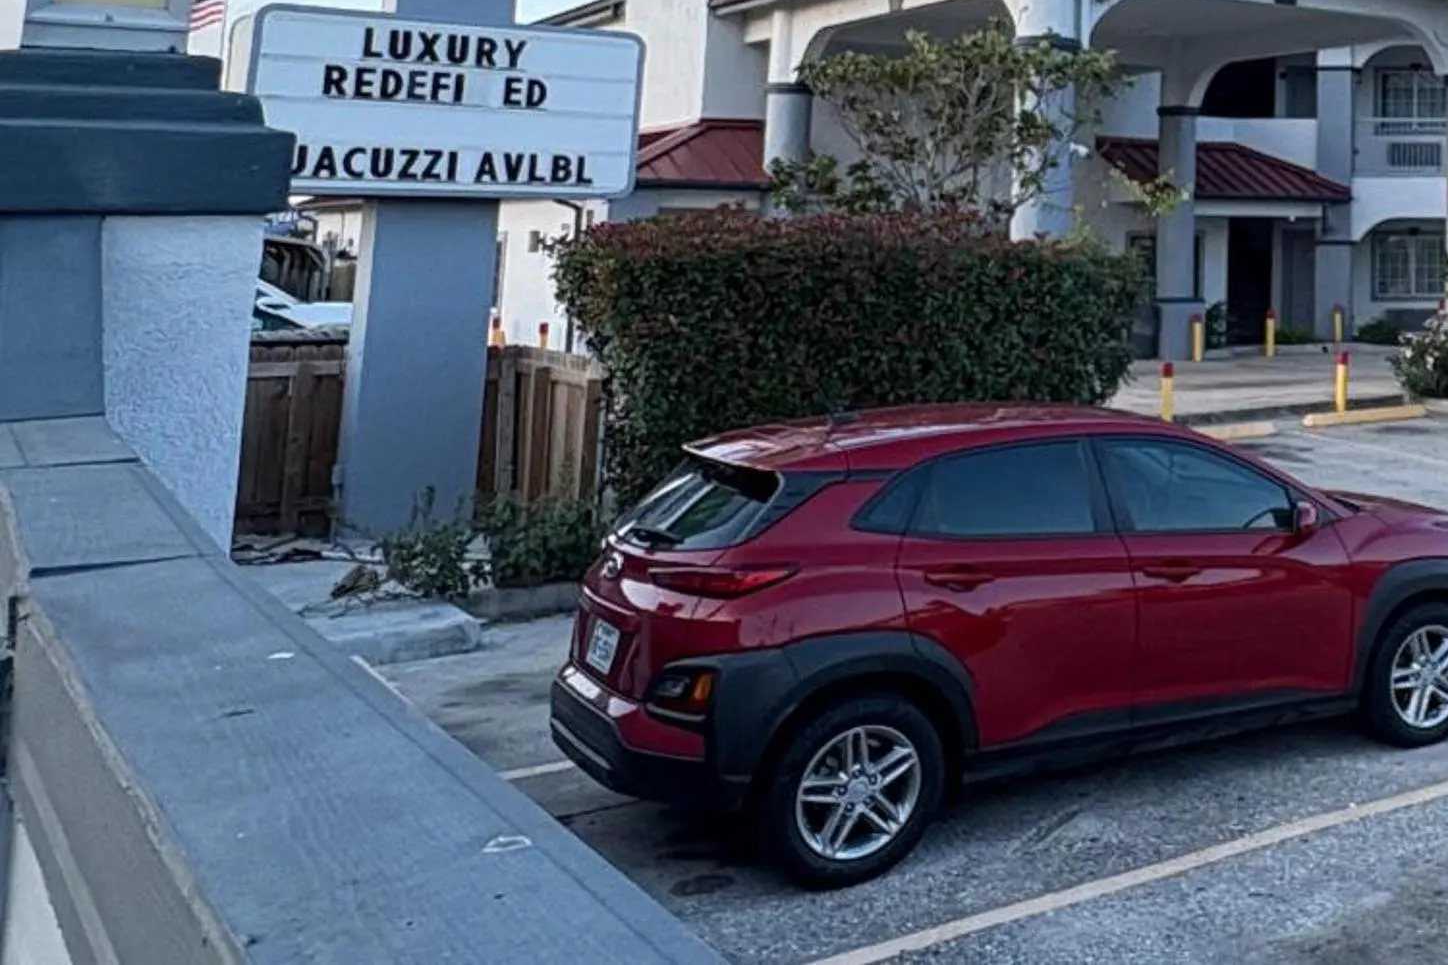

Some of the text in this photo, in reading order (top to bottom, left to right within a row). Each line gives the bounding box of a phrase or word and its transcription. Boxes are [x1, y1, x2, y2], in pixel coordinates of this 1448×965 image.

[362, 27, 527, 69] LUXURY
[289, 145, 593, 185] JACUZZI AVLBL
